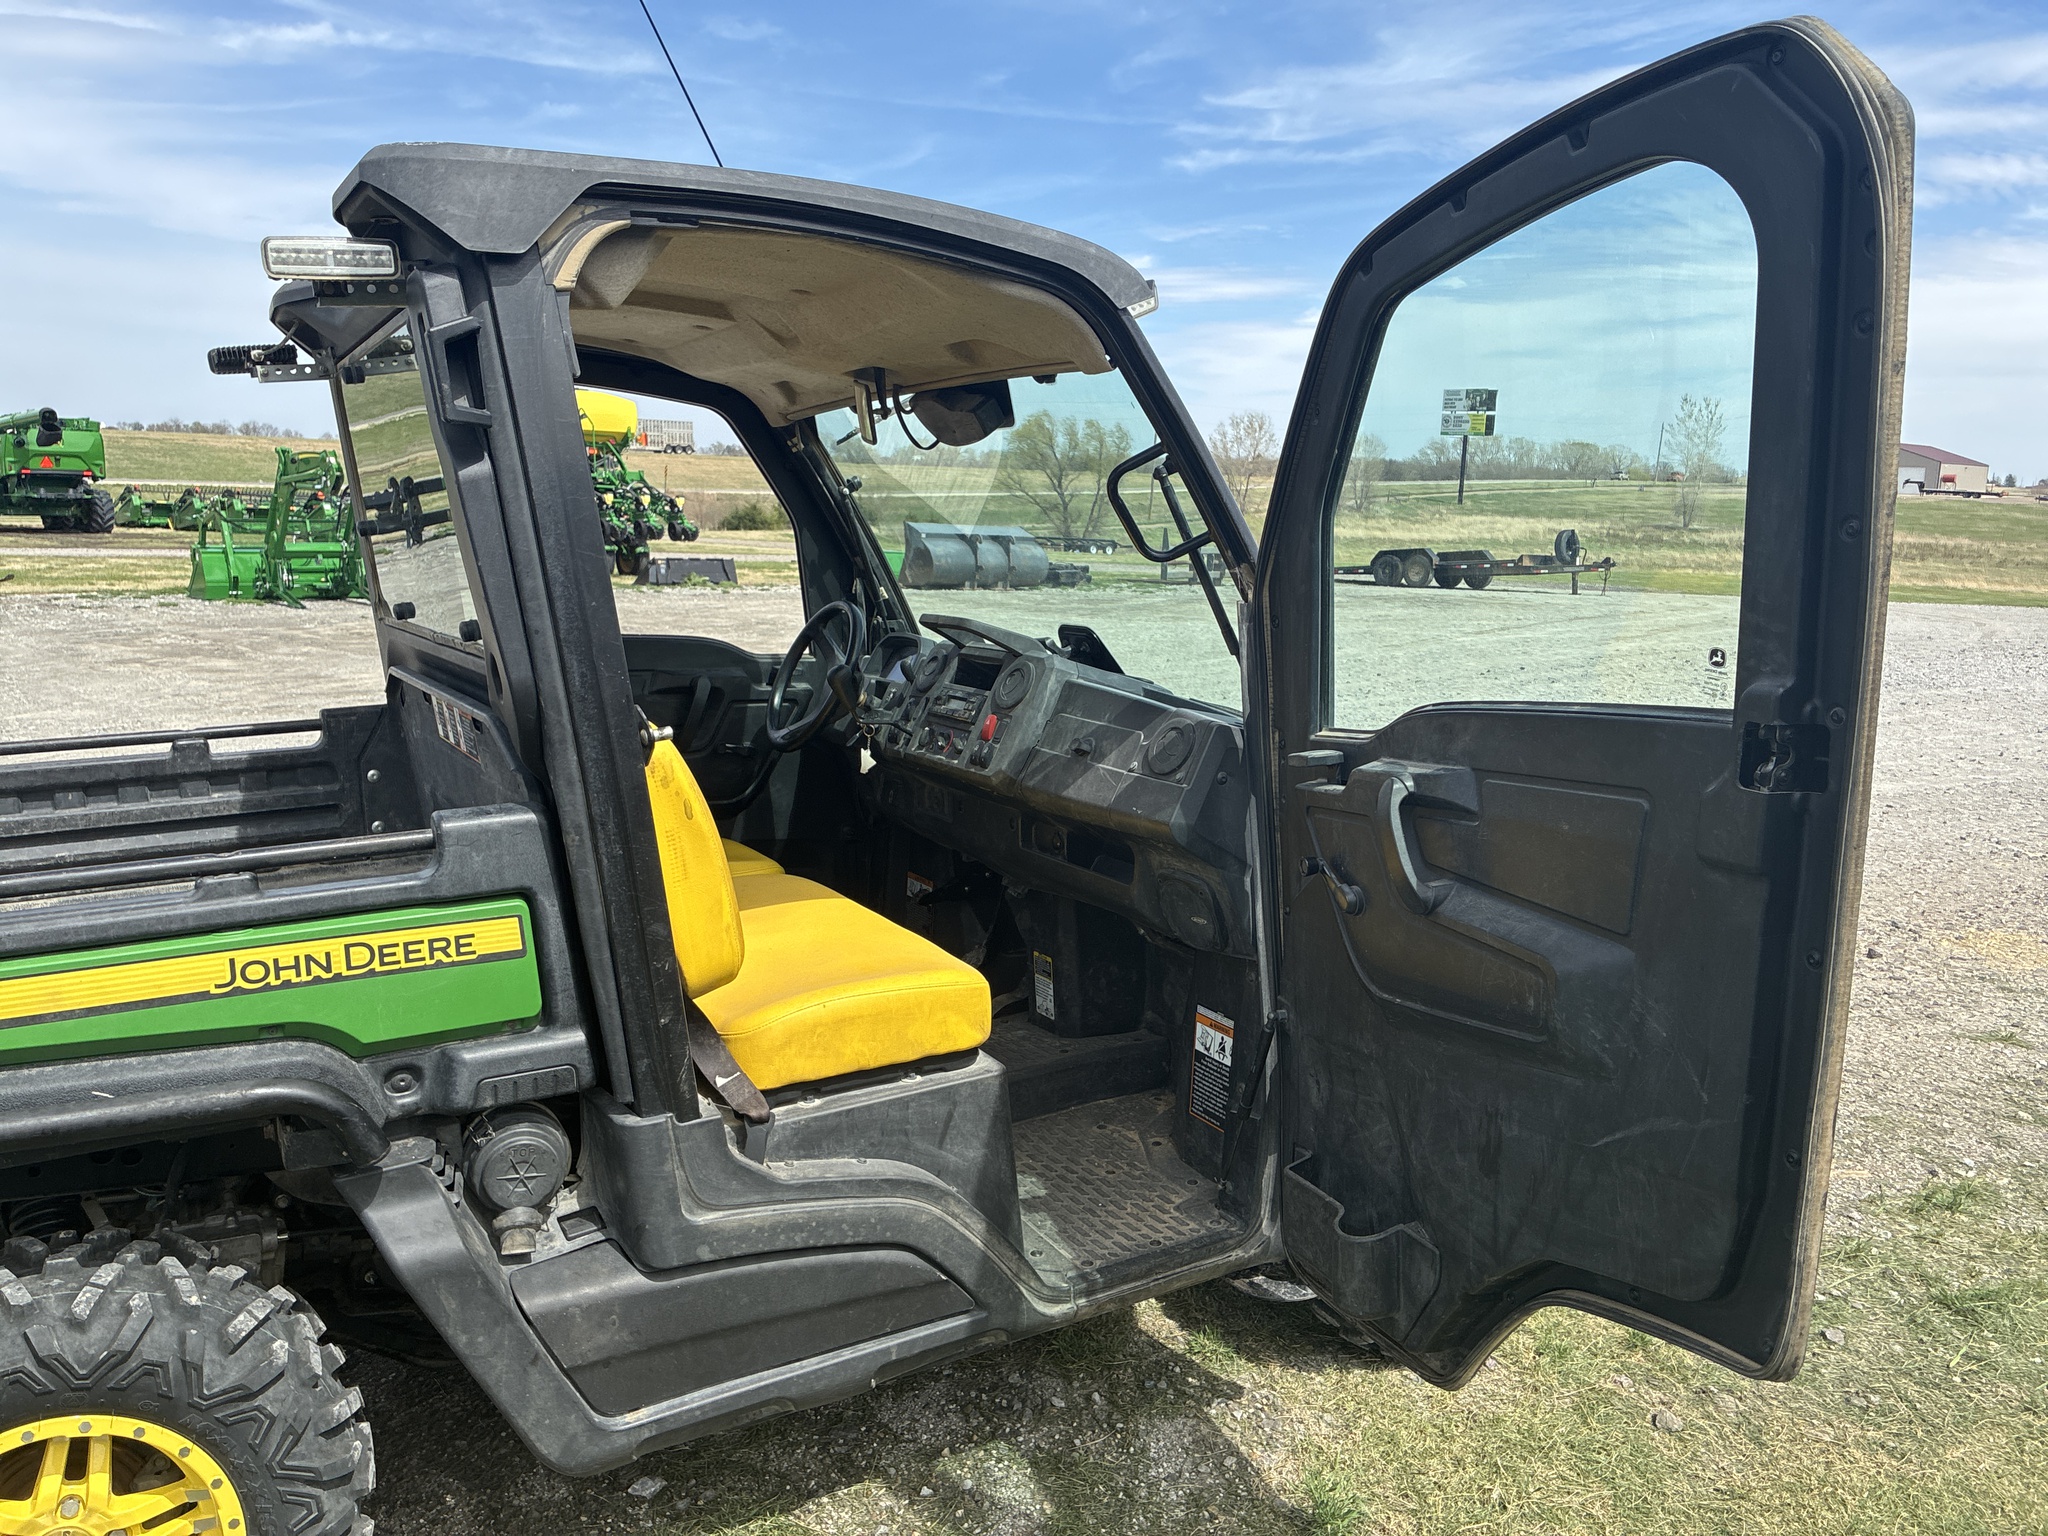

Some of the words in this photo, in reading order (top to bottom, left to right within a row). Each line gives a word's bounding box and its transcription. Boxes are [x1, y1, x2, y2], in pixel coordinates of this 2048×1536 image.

[214, 951, 333, 989] JOHN
[343, 933, 477, 972] DEERE
[510, 1147, 536, 1157] TOP
